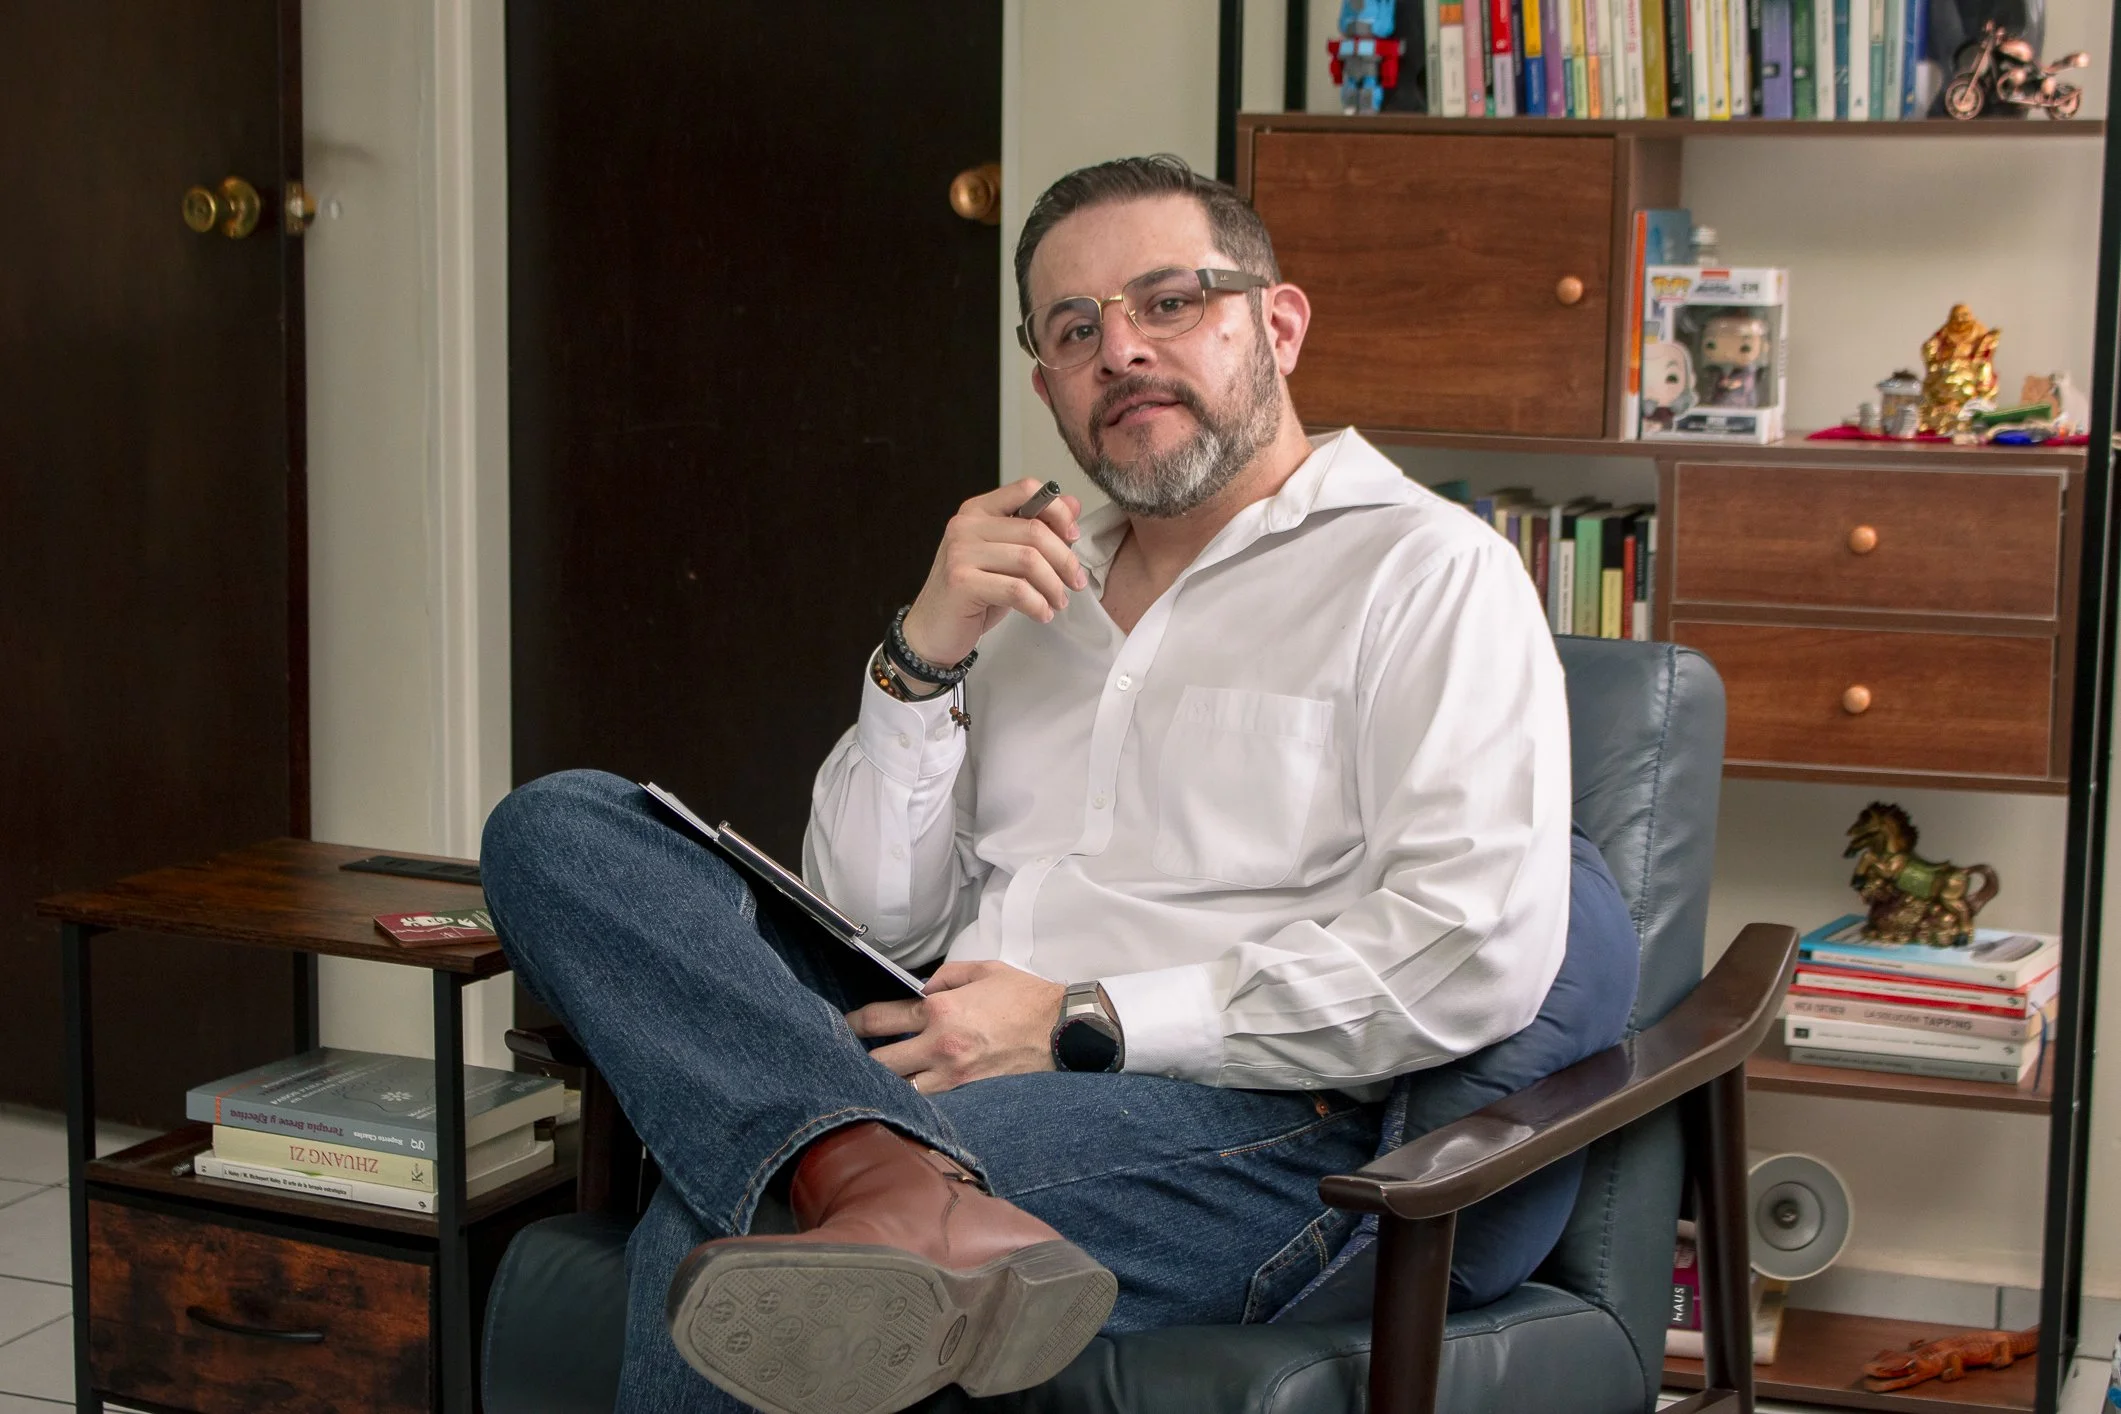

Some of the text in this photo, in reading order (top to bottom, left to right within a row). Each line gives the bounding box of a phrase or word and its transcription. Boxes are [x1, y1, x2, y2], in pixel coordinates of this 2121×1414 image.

[230, 1109, 268, 1125] Efectiva
[278, 1116, 305, 1131] Breve
[306, 1120, 344, 1137] Terapia
[289, 1144, 379, 1174] ZHUANG ZI
[1672, 1287, 1685, 1322] HAUS
